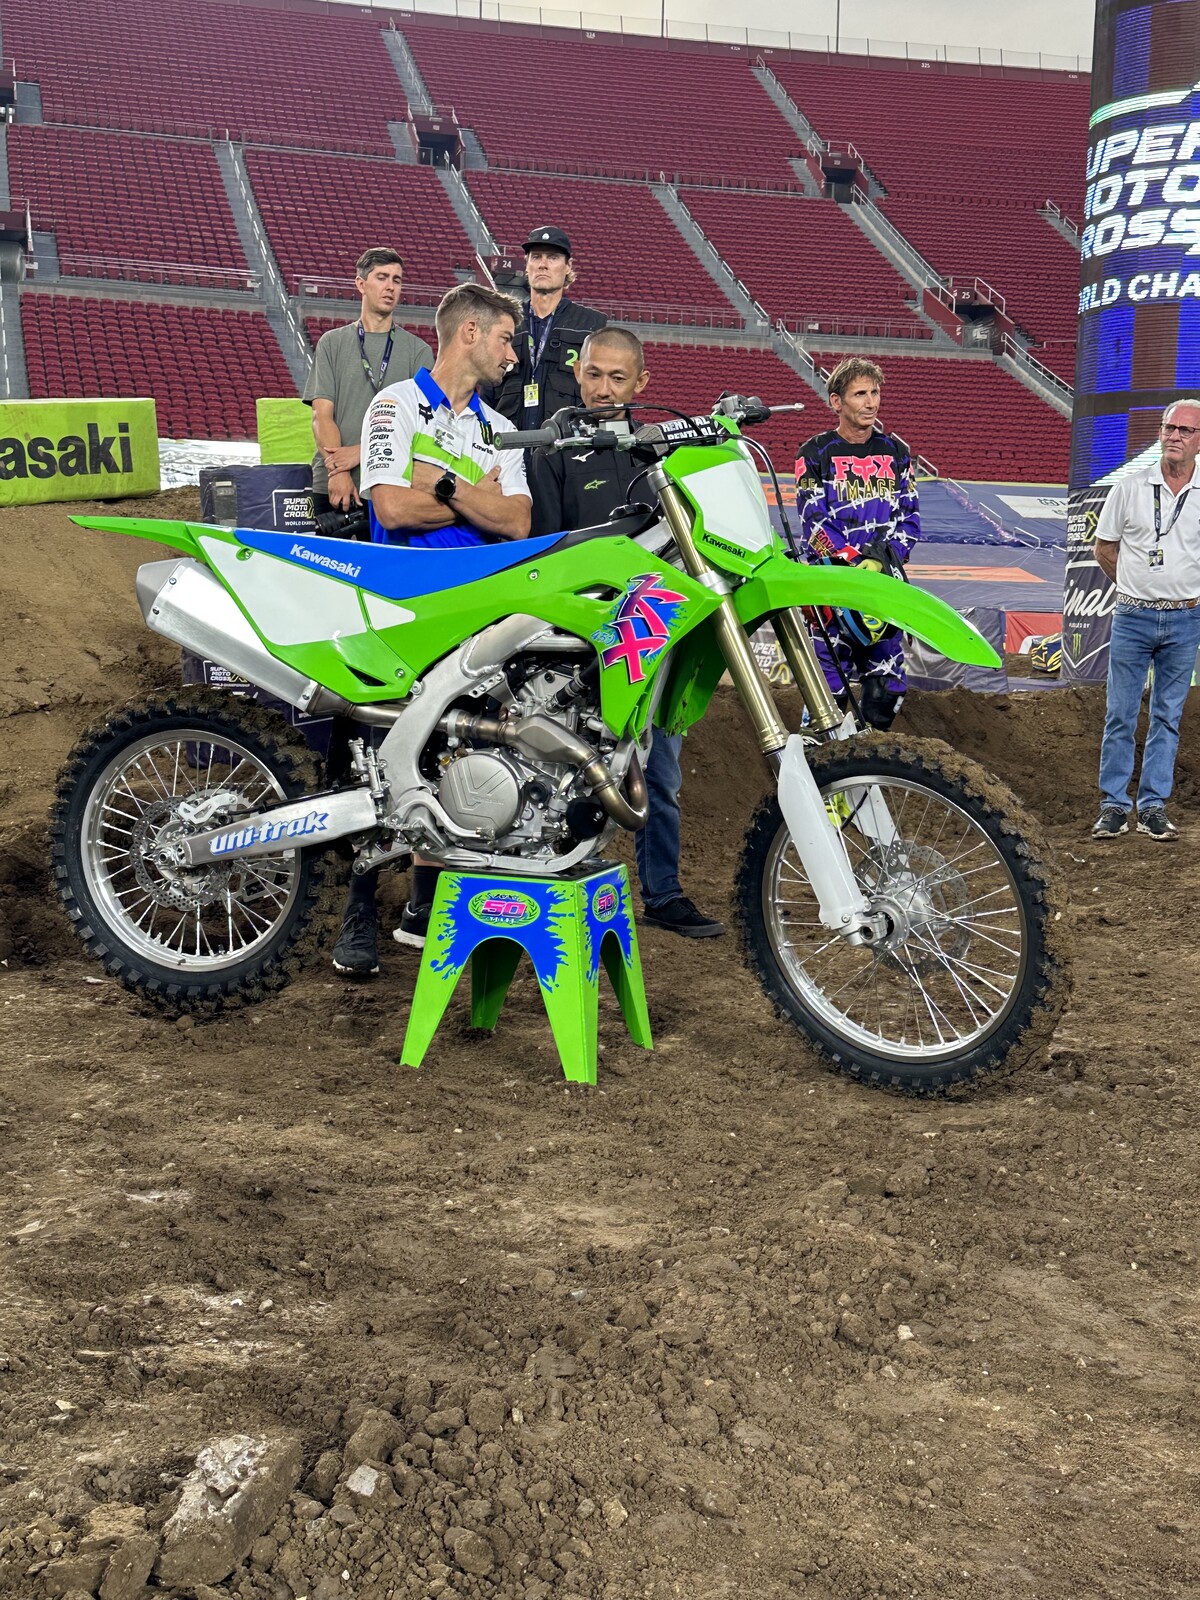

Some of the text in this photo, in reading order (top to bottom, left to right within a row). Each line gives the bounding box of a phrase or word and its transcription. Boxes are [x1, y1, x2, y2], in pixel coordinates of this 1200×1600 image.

[502, 260, 512, 268] 24
[961, 291, 971, 299] 25
[836, 479, 896, 502] IMAGE
[702, 533, 746, 559] Kawasaki
[289, 543, 362, 578] Kawasaki
[208, 811, 329, 855] uni-trak
[481, 900, 527, 917] 50
